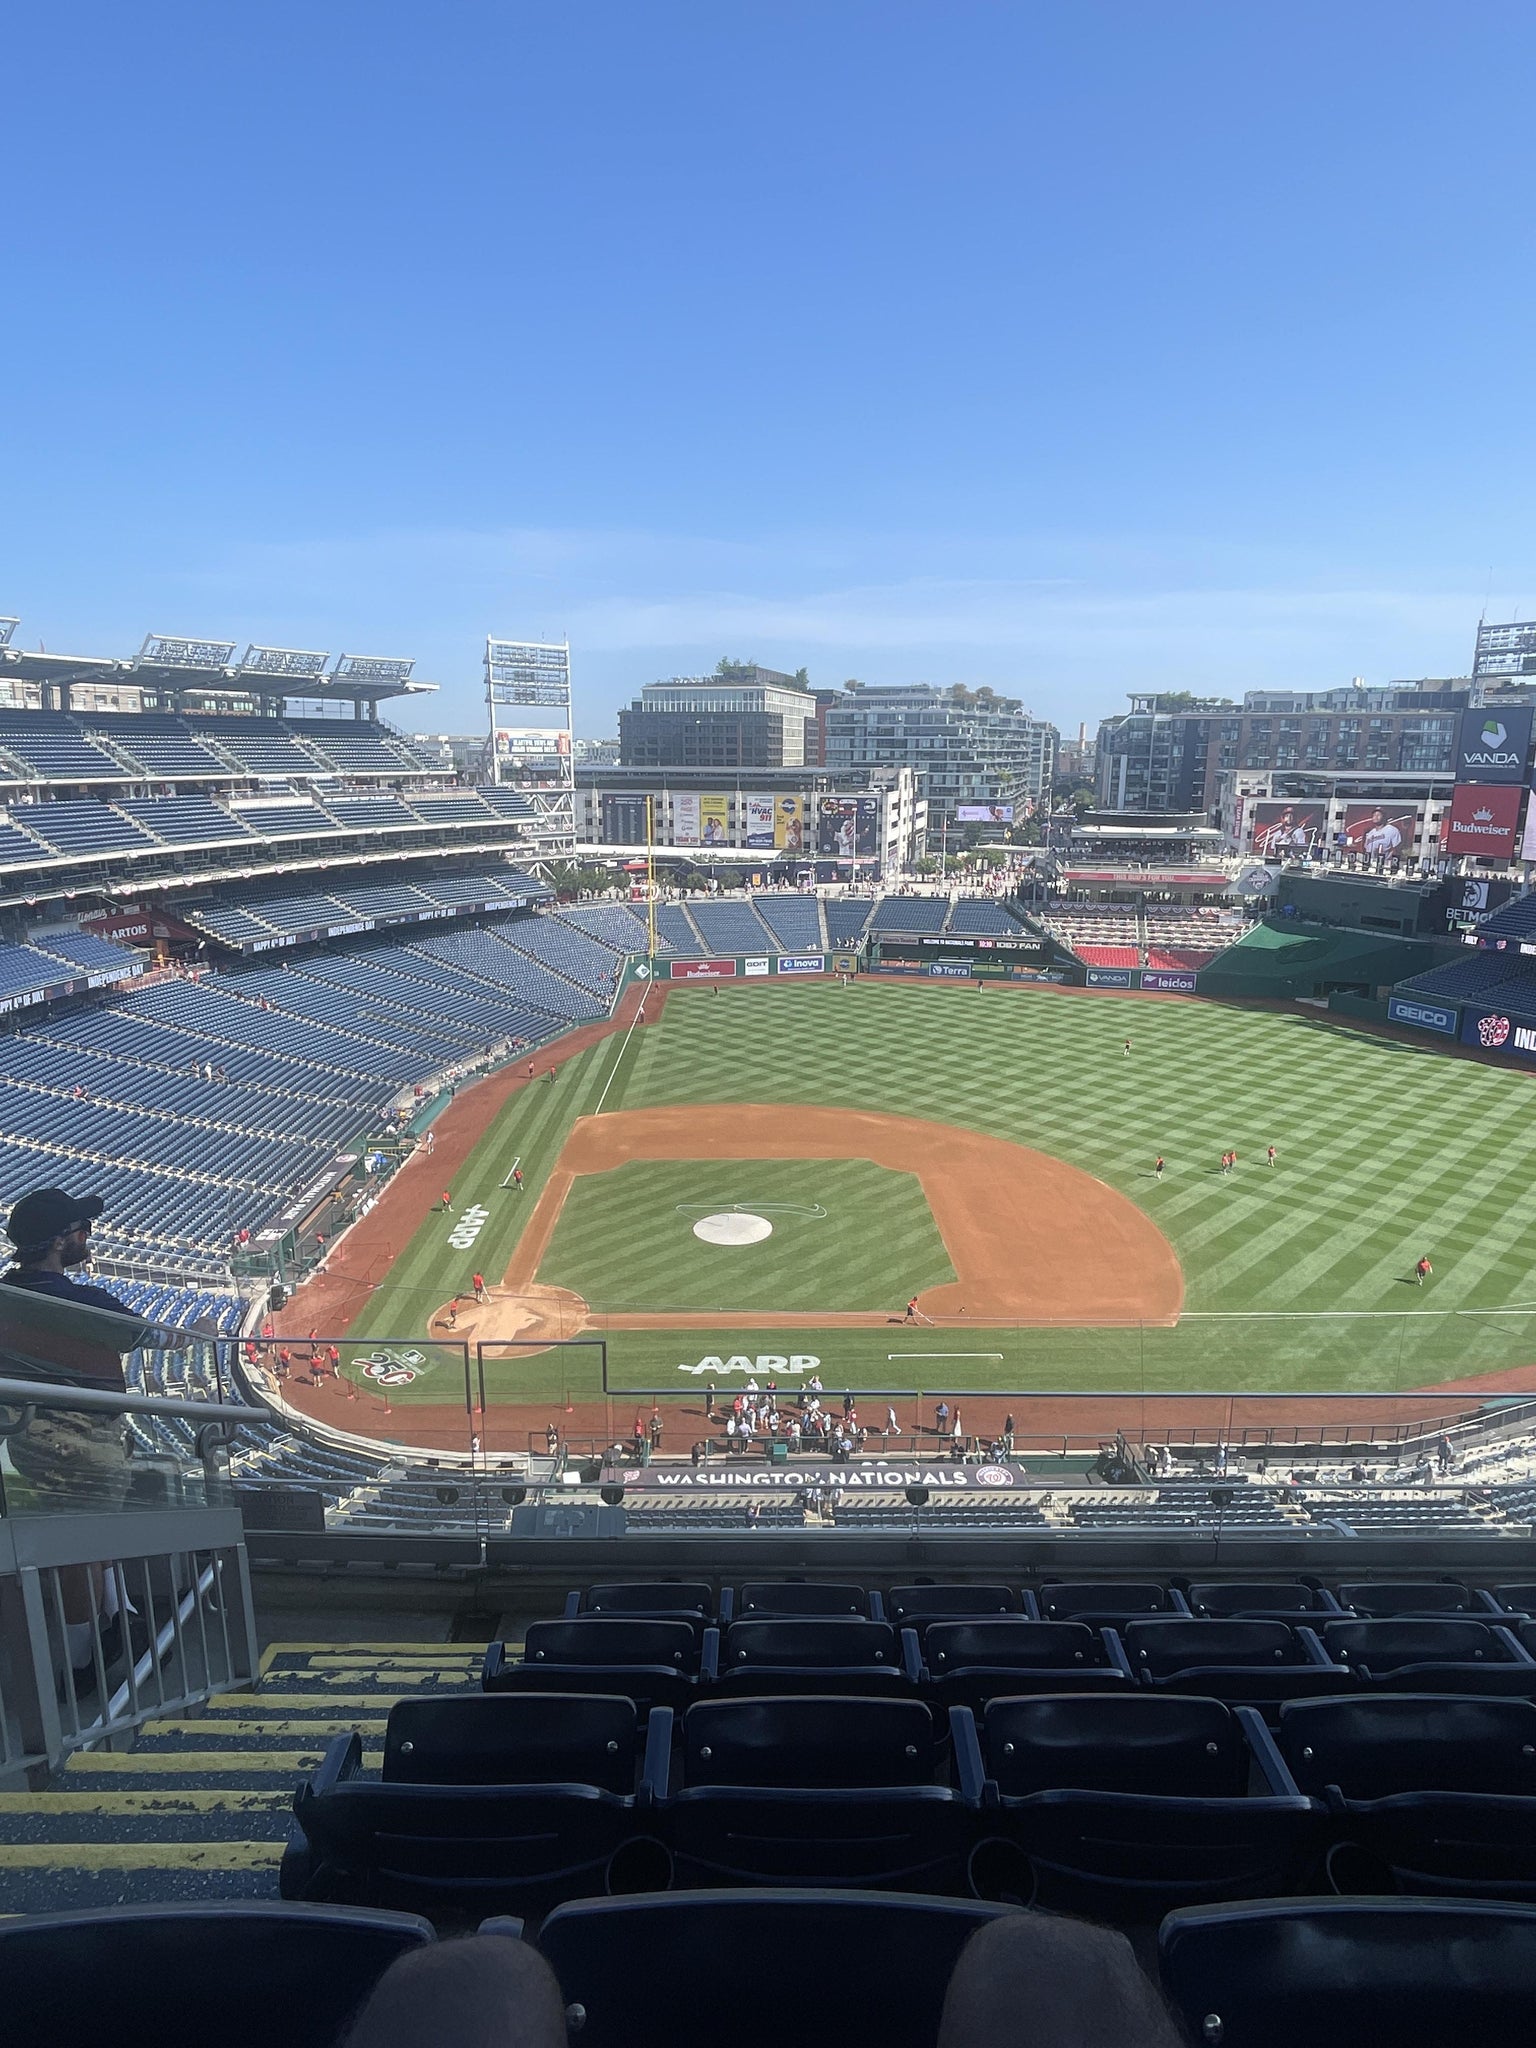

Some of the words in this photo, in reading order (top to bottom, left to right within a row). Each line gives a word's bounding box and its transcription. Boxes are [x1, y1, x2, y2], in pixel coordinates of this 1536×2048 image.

[1464, 752, 1520, 765] VANDA
[1452, 821, 1511, 836] Budweiser
[111, 924, 148, 940] ARTOIS
[1019, 942, 1041, 950] FAN
[1465, 935, 1479, 945] JULY
[746, 960, 768, 968] GDIT
[794, 959, 819, 967] Inova
[87, 965, 132, 989] INDEPENDENCE
[131, 962, 144, 977] DAY
[943, 966, 968, 977] Terra
[1158, 977, 1193, 989] leidos
[23, 994, 31, 1006] OF
[31, 989, 45, 1003] JULY
[1395, 1004, 1448, 1027] GEICO
[447, 1203, 490, 1249] AARP
[351, 1352, 416, 1386] 250
[677, 1355, 821, 1375] AARP
[657, 1472, 822, 1485] WASHINGTON
[829, 1471, 968, 1485] NATIONALS
